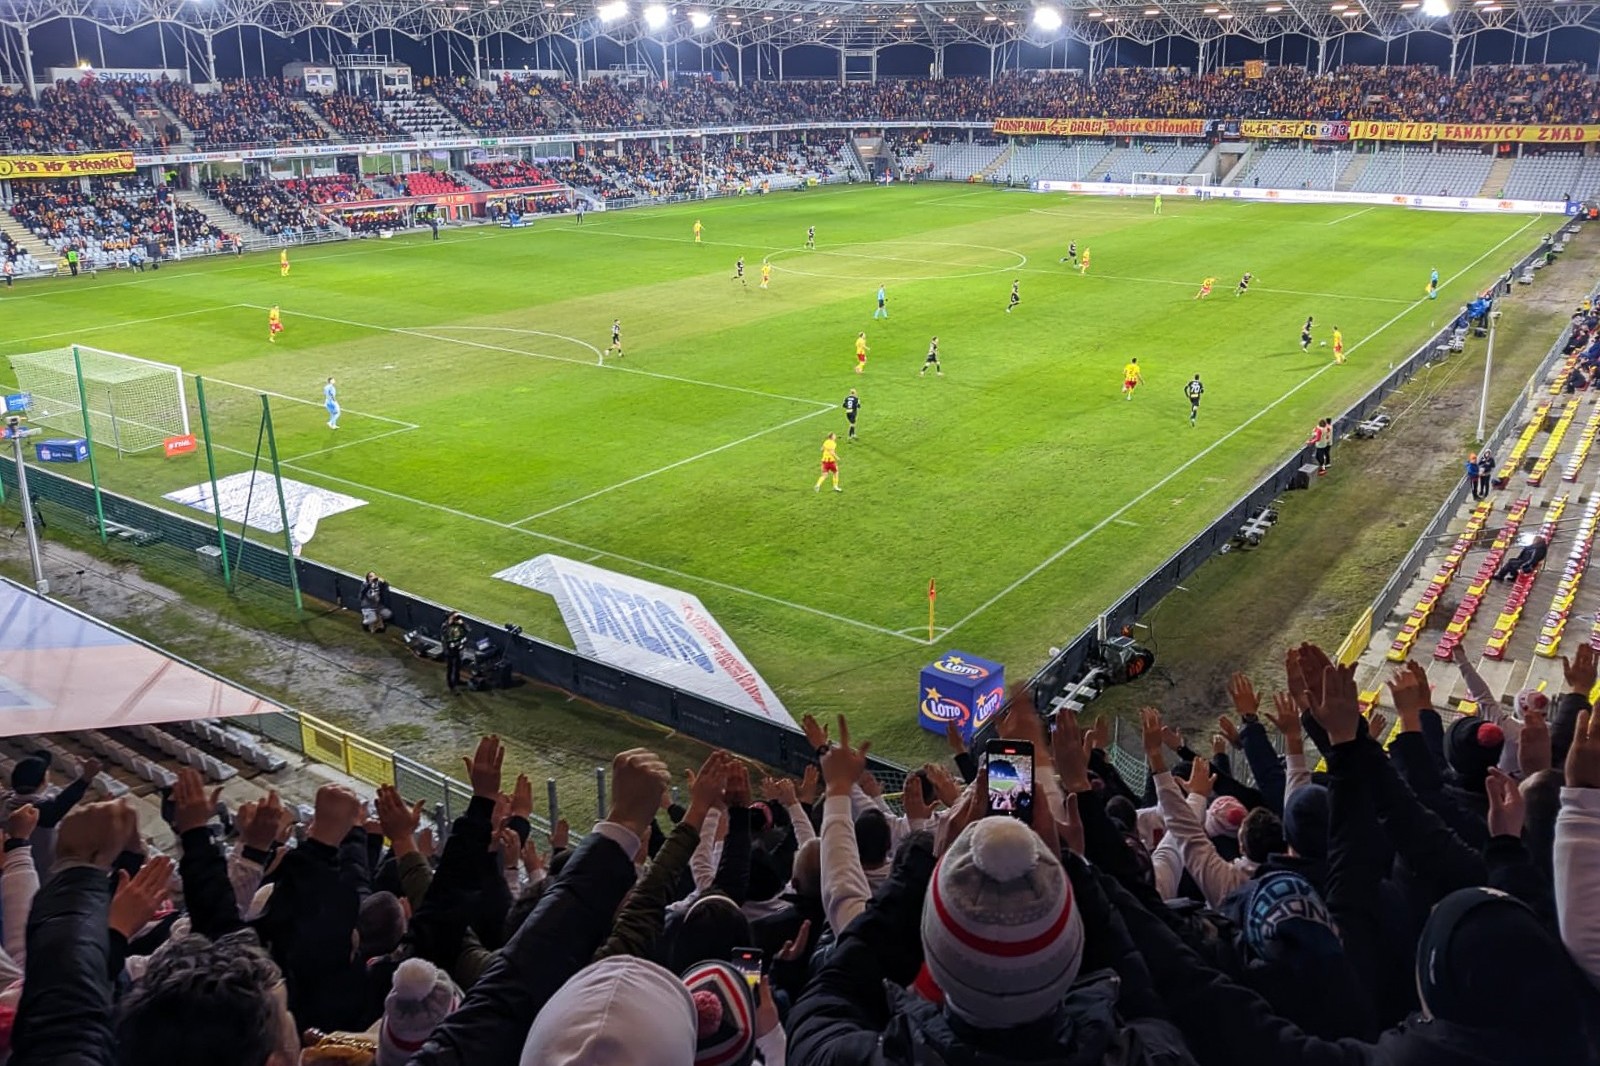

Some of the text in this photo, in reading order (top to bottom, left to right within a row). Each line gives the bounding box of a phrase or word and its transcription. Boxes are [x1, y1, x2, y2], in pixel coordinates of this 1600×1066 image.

[99, 72, 152, 81] SUZUKI
[995, 119, 1047, 133] KOMPANIA
[1107, 119, 1141, 133] Dobre
[1303, 123, 1348, 136] EG 73
[1445, 126, 1525, 139] FANATYCY
[1537, 127, 1586, 141] ZNAD
[1190, 383, 1201, 394] 70
[847, 400, 853, 409] 9
[945, 661, 979, 675] LOTTO
[930, 699, 961, 718] LOTTO
[979, 693, 998, 720] LOTTO
